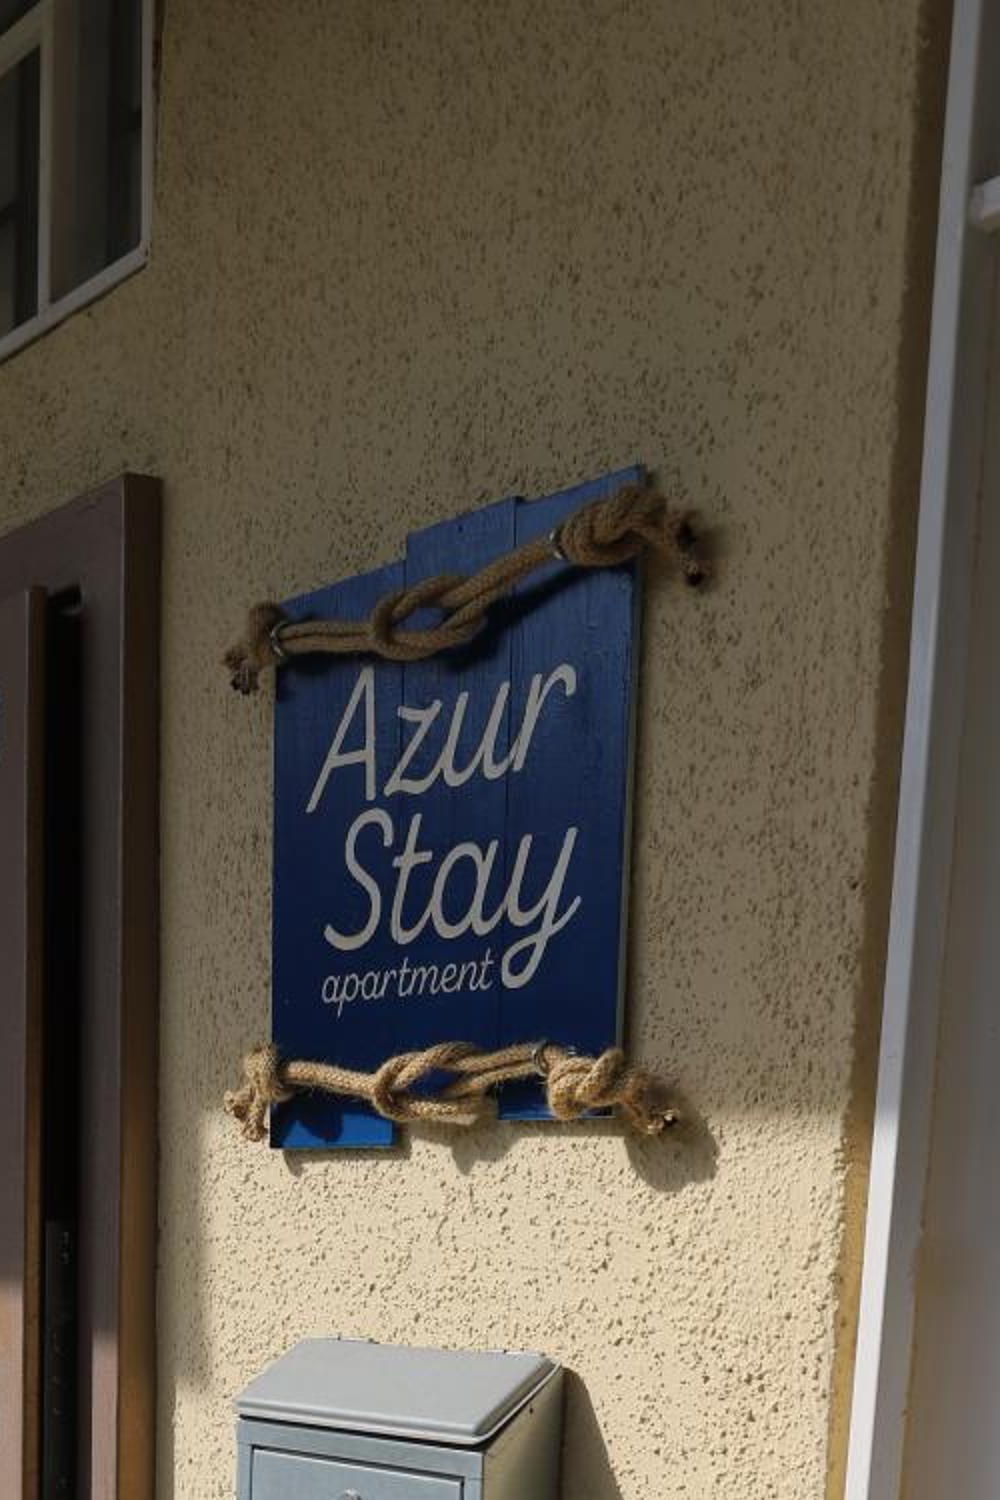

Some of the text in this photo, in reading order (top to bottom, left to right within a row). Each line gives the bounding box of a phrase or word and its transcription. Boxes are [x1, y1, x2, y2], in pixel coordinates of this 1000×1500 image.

[306, 663, 577, 813] Azur
[323, 808, 582, 989] Stay
[321, 948, 494, 1017] apartment
